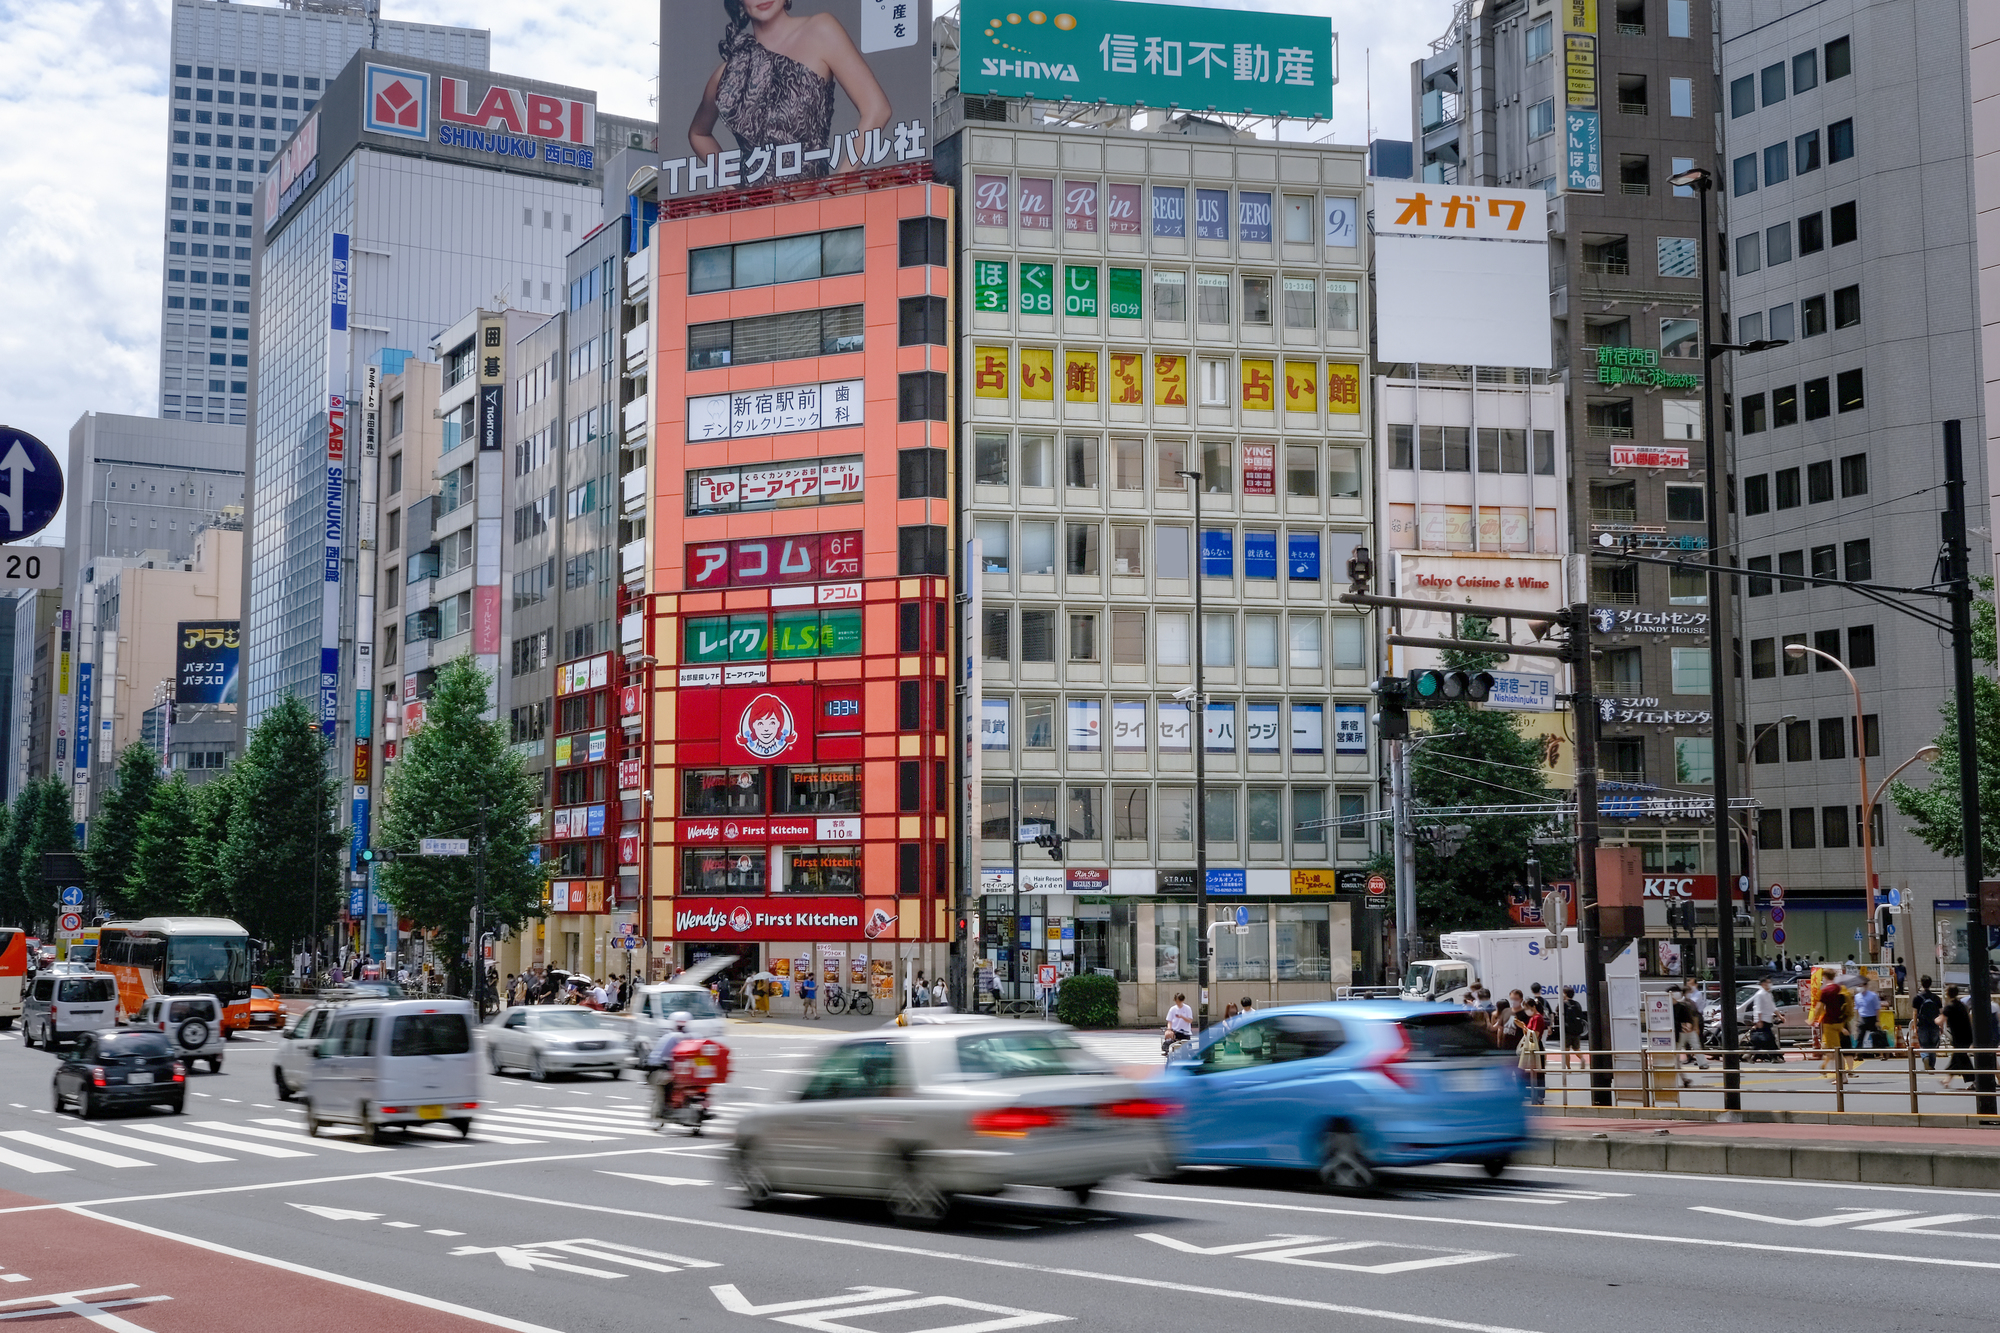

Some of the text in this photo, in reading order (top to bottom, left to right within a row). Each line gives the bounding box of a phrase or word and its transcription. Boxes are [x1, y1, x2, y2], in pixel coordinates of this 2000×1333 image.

[1099, 33, 1315, 86] 信和不動産
[980, 57, 1080, 82] SHINWA
[440, 76, 595, 147] LABI
[439, 124, 594, 170] SHINJUKU 西口館
[1568, 115, 1585, 186] なんぼや
[1586, 117, 1598, 173] ブランド買取
[661, 119, 926, 195] THEグローバル社
[1239, 202, 1271, 226] ZERO
[1394, 192, 1526, 231] オガワ
[337, 275, 348, 306] LABI
[1198, 277, 1227, 286] Garden
[1111, 303, 1140, 315] 60分
[976, 356, 1096, 393] 占い館
[1242, 368, 1358, 405] 占い館
[733, 388, 816, 417] 新宿駅前
[834, 385, 850, 423] 歯科
[702, 411, 820, 437] デンタルクリニック
[328, 410, 344, 461] LABI
[1245, 447, 1272, 457] YING
[1613, 452, 1690, 467] いい部屋ネット
[1244, 457, 1272, 467] 中国語
[741, 464, 855, 481] くらくカンタンお部屋さがし
[326, 467, 342, 540] SHINJUKU
[831, 537, 854, 554] 6F
[325, 546, 340, 582] 西口館
[696, 541, 812, 582] アコム
[841, 562, 858, 574] 入口
[1416, 573, 1550, 590] Tokyo Cuisine & Wine
[822, 586, 859, 600] アコム
[484, 598, 492, 645] ワールドメイト
[1624, 625, 1706, 634] by DANDY HOUSE
[699, 627, 761, 654] レイク
[183, 662, 225, 673] パチンコ
[725, 669, 766, 680] エーアイアール
[183, 675, 224, 685] パチスロ
[1490, 677, 1549, 696] 西新宿一丁目
[325, 690, 336, 721] LABI
[828, 699, 859, 716] 1334
[1494, 693, 1538, 705] Nishishinjuku
[1621, 697, 1659, 708] ミスパリ
[79, 674, 90, 751] アートネイチャー
[1340, 719, 1359, 731] 新宿
[1336, 731, 1364, 743] 営業所
[356, 746, 367, 778] トレカ
[687, 823, 809, 839] Wendy's First Kitchen
[1294, 870, 1321, 885] 占い館
[572, 890, 584, 903] au
[1643, 878, 1694, 897] KFC
[1772, 887, 1781, 896] 40
[676, 907, 859, 932] Wendy's First Kitchen
